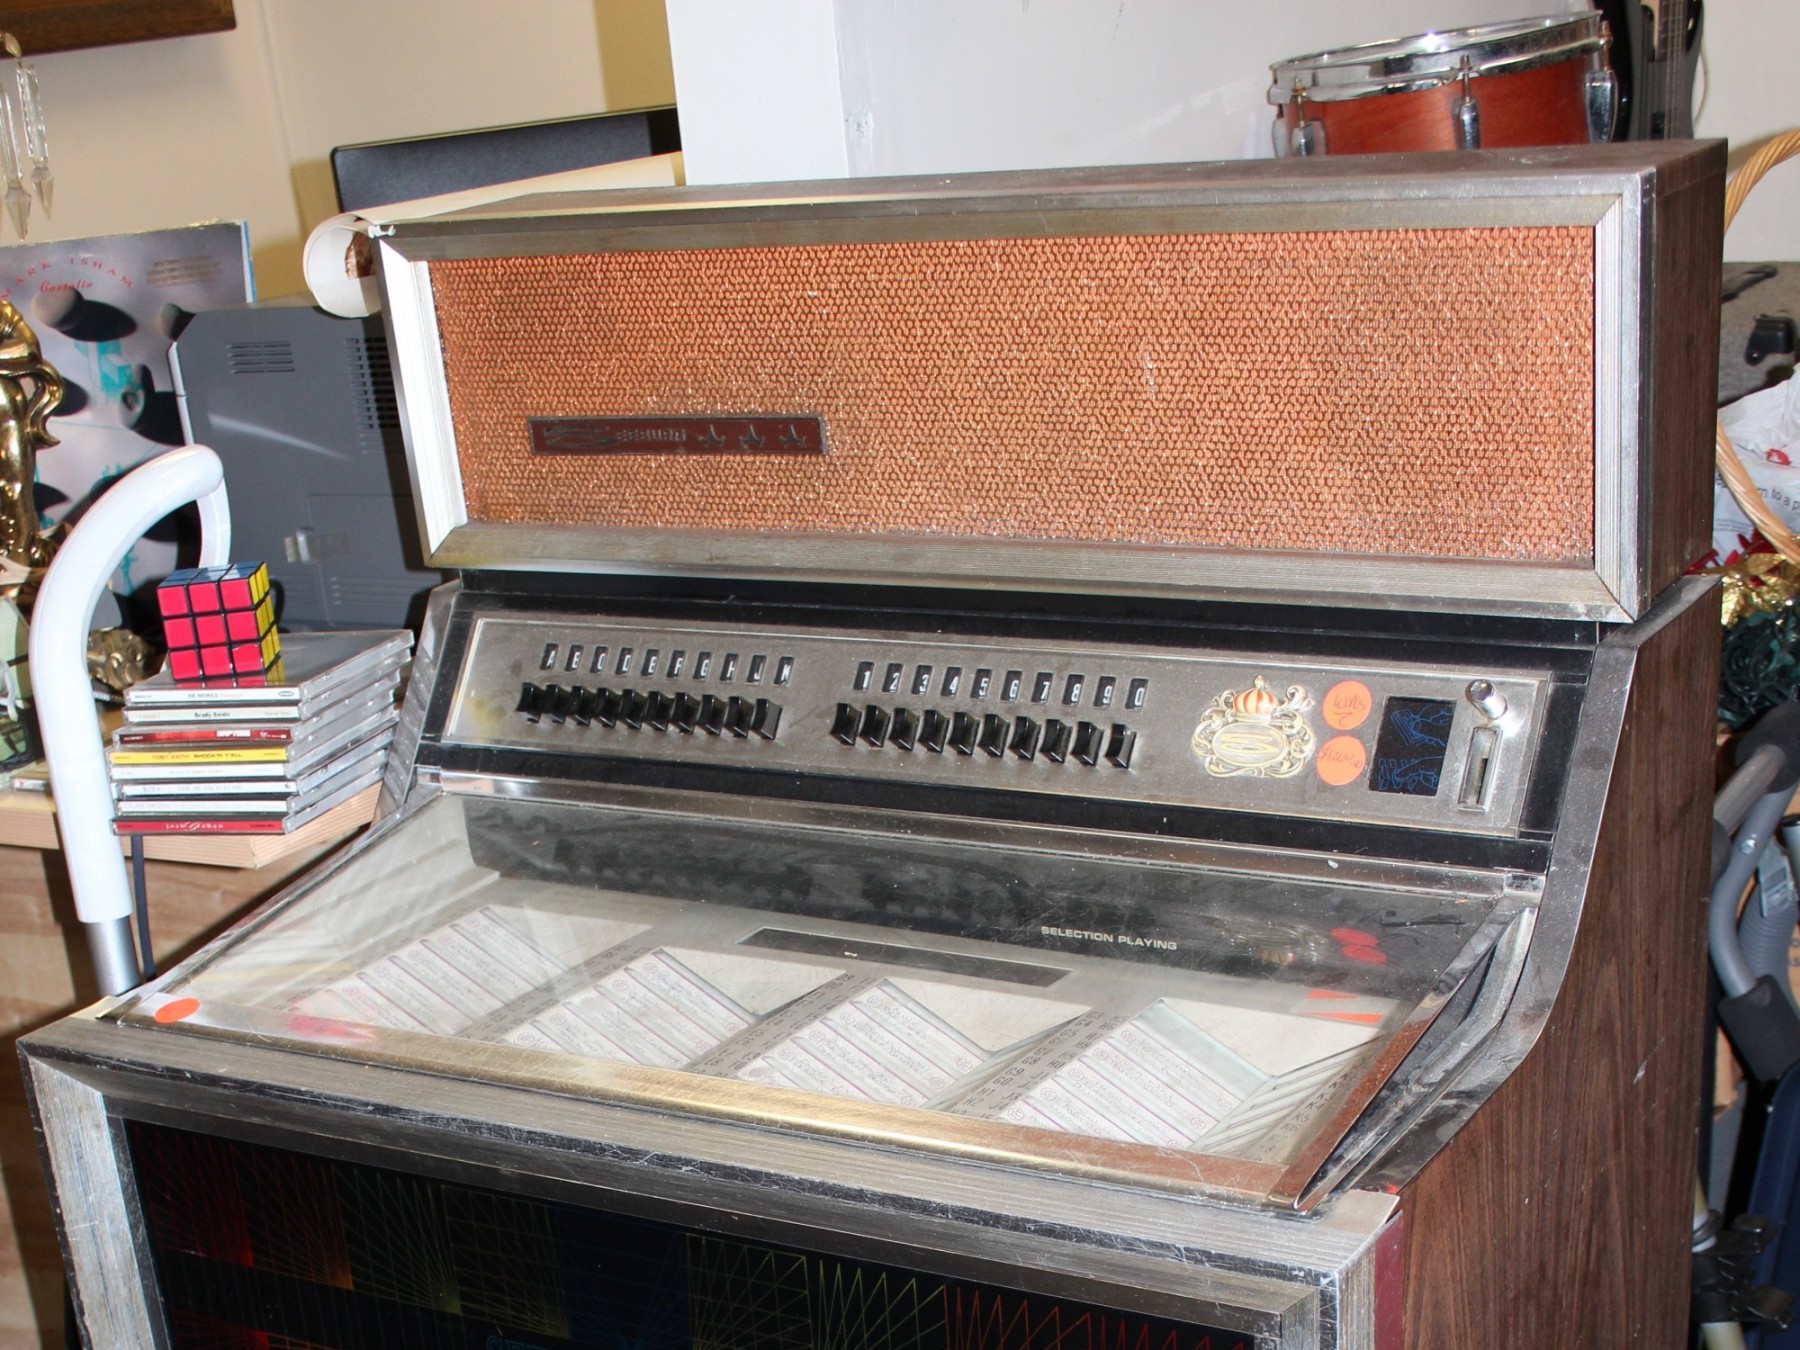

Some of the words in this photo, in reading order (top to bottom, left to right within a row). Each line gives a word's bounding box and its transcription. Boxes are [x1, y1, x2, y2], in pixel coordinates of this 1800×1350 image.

[70, 256, 134, 289] ISHAM
[547, 651, 556, 666] A
[597, 654, 606, 669] C
[673, 657, 683, 673] F
[726, 661, 736, 677] H
[753, 662, 763, 679] J
[862, 671, 870, 689] 1
[890, 672, 900, 690] 2
[918, 674, 929, 692] 3
[948, 676, 959, 693] 4
[978, 678, 989, 695] 5
[1008, 680, 1019, 697] 6
[1040, 682, 1050, 699] 7
[1070, 683, 1080, 701] 8
[1101, 686, 1112, 703] 9
[1041, 926, 1113, 942] SELECTION
[1118, 935, 1177, 950] PLAYING
